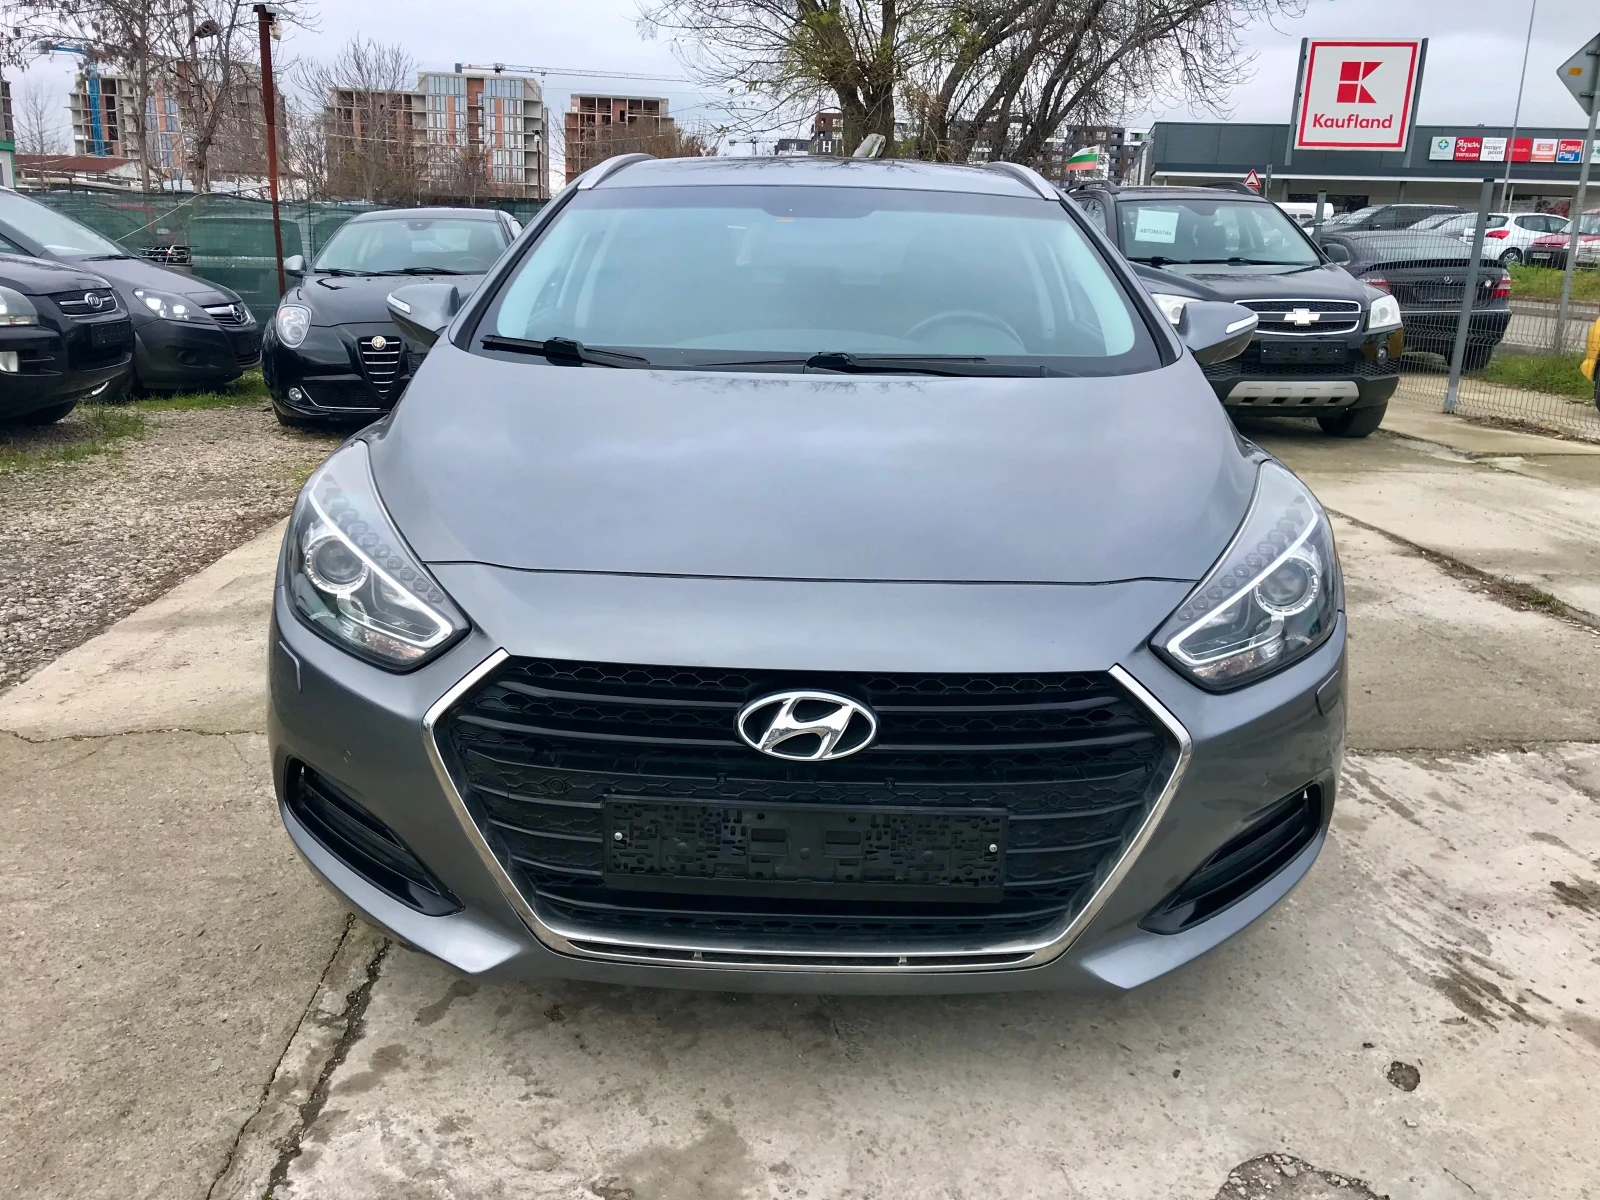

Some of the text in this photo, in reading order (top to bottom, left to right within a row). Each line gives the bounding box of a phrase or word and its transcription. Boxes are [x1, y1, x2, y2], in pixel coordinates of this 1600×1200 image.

[1312, 113, 1393, 129] Kaufland
[1560, 143, 1581, 152] Easy
[1559, 152, 1575, 160] Pay
[1139, 228, 1172, 236] АВТОМАТИК
